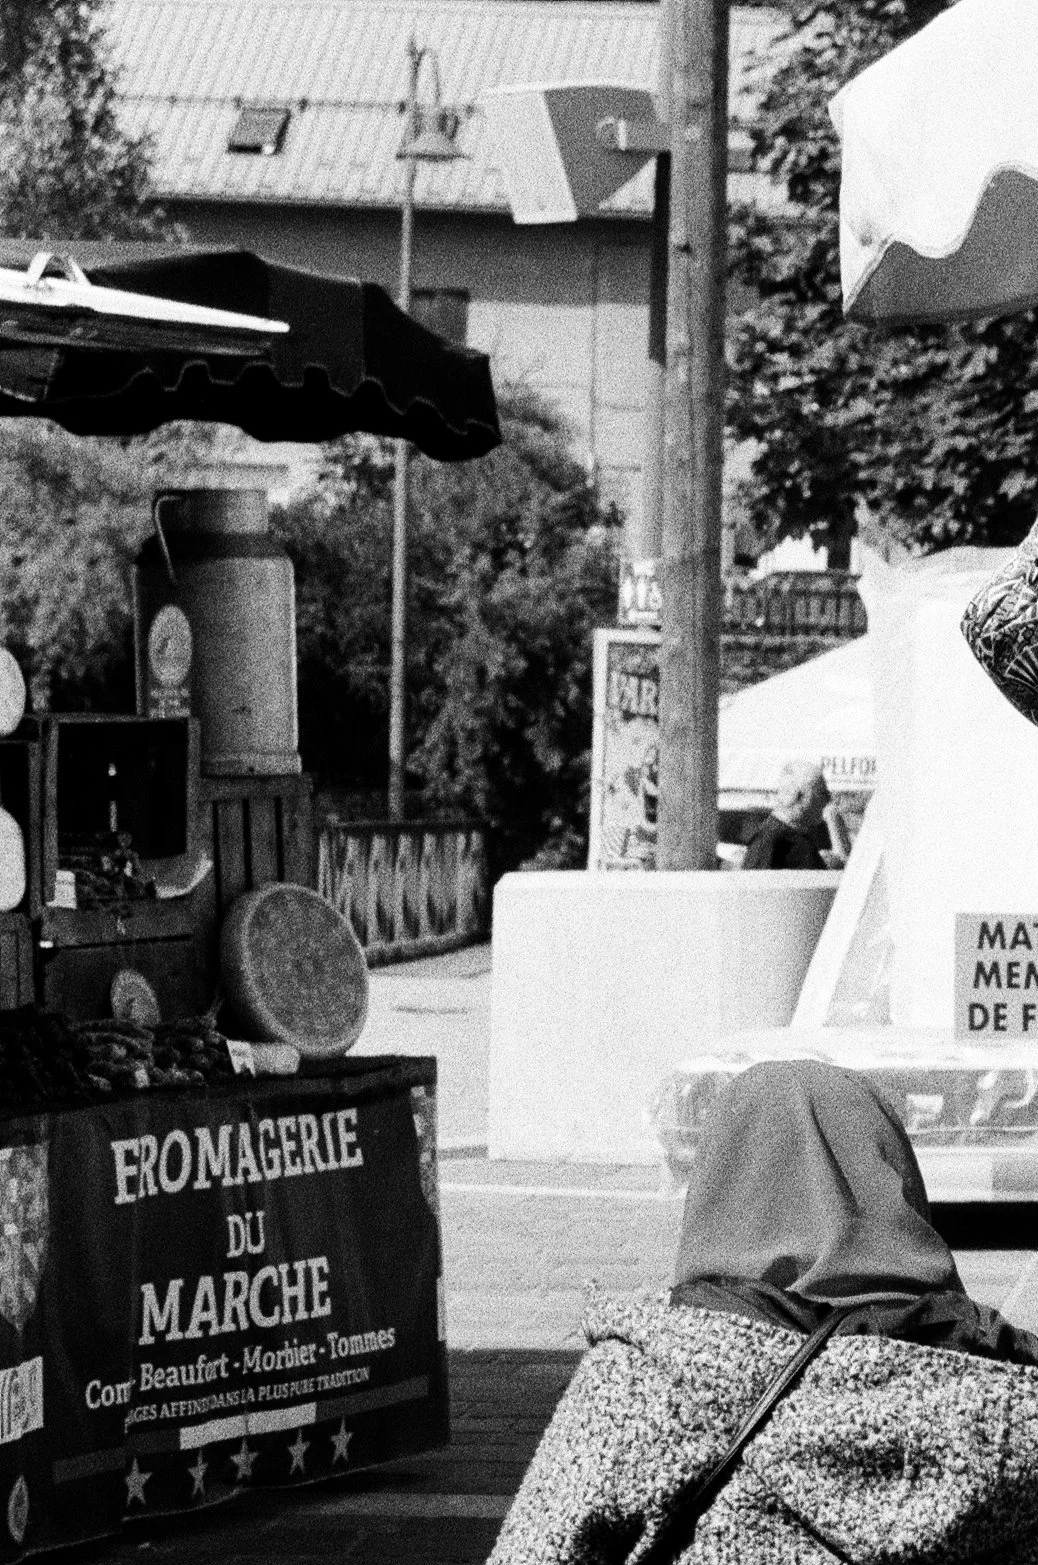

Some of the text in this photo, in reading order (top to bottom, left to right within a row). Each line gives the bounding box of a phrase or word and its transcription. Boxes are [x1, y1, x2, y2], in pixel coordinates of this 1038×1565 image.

[968, 1002, 1008, 1032] DE
[110, 1107, 364, 1205] FROMAGERIE
[226, 1210, 266, 1258] DU
[138, 1255, 332, 1346] MARCHE
[326, 1327, 396, 1360] Tommes
